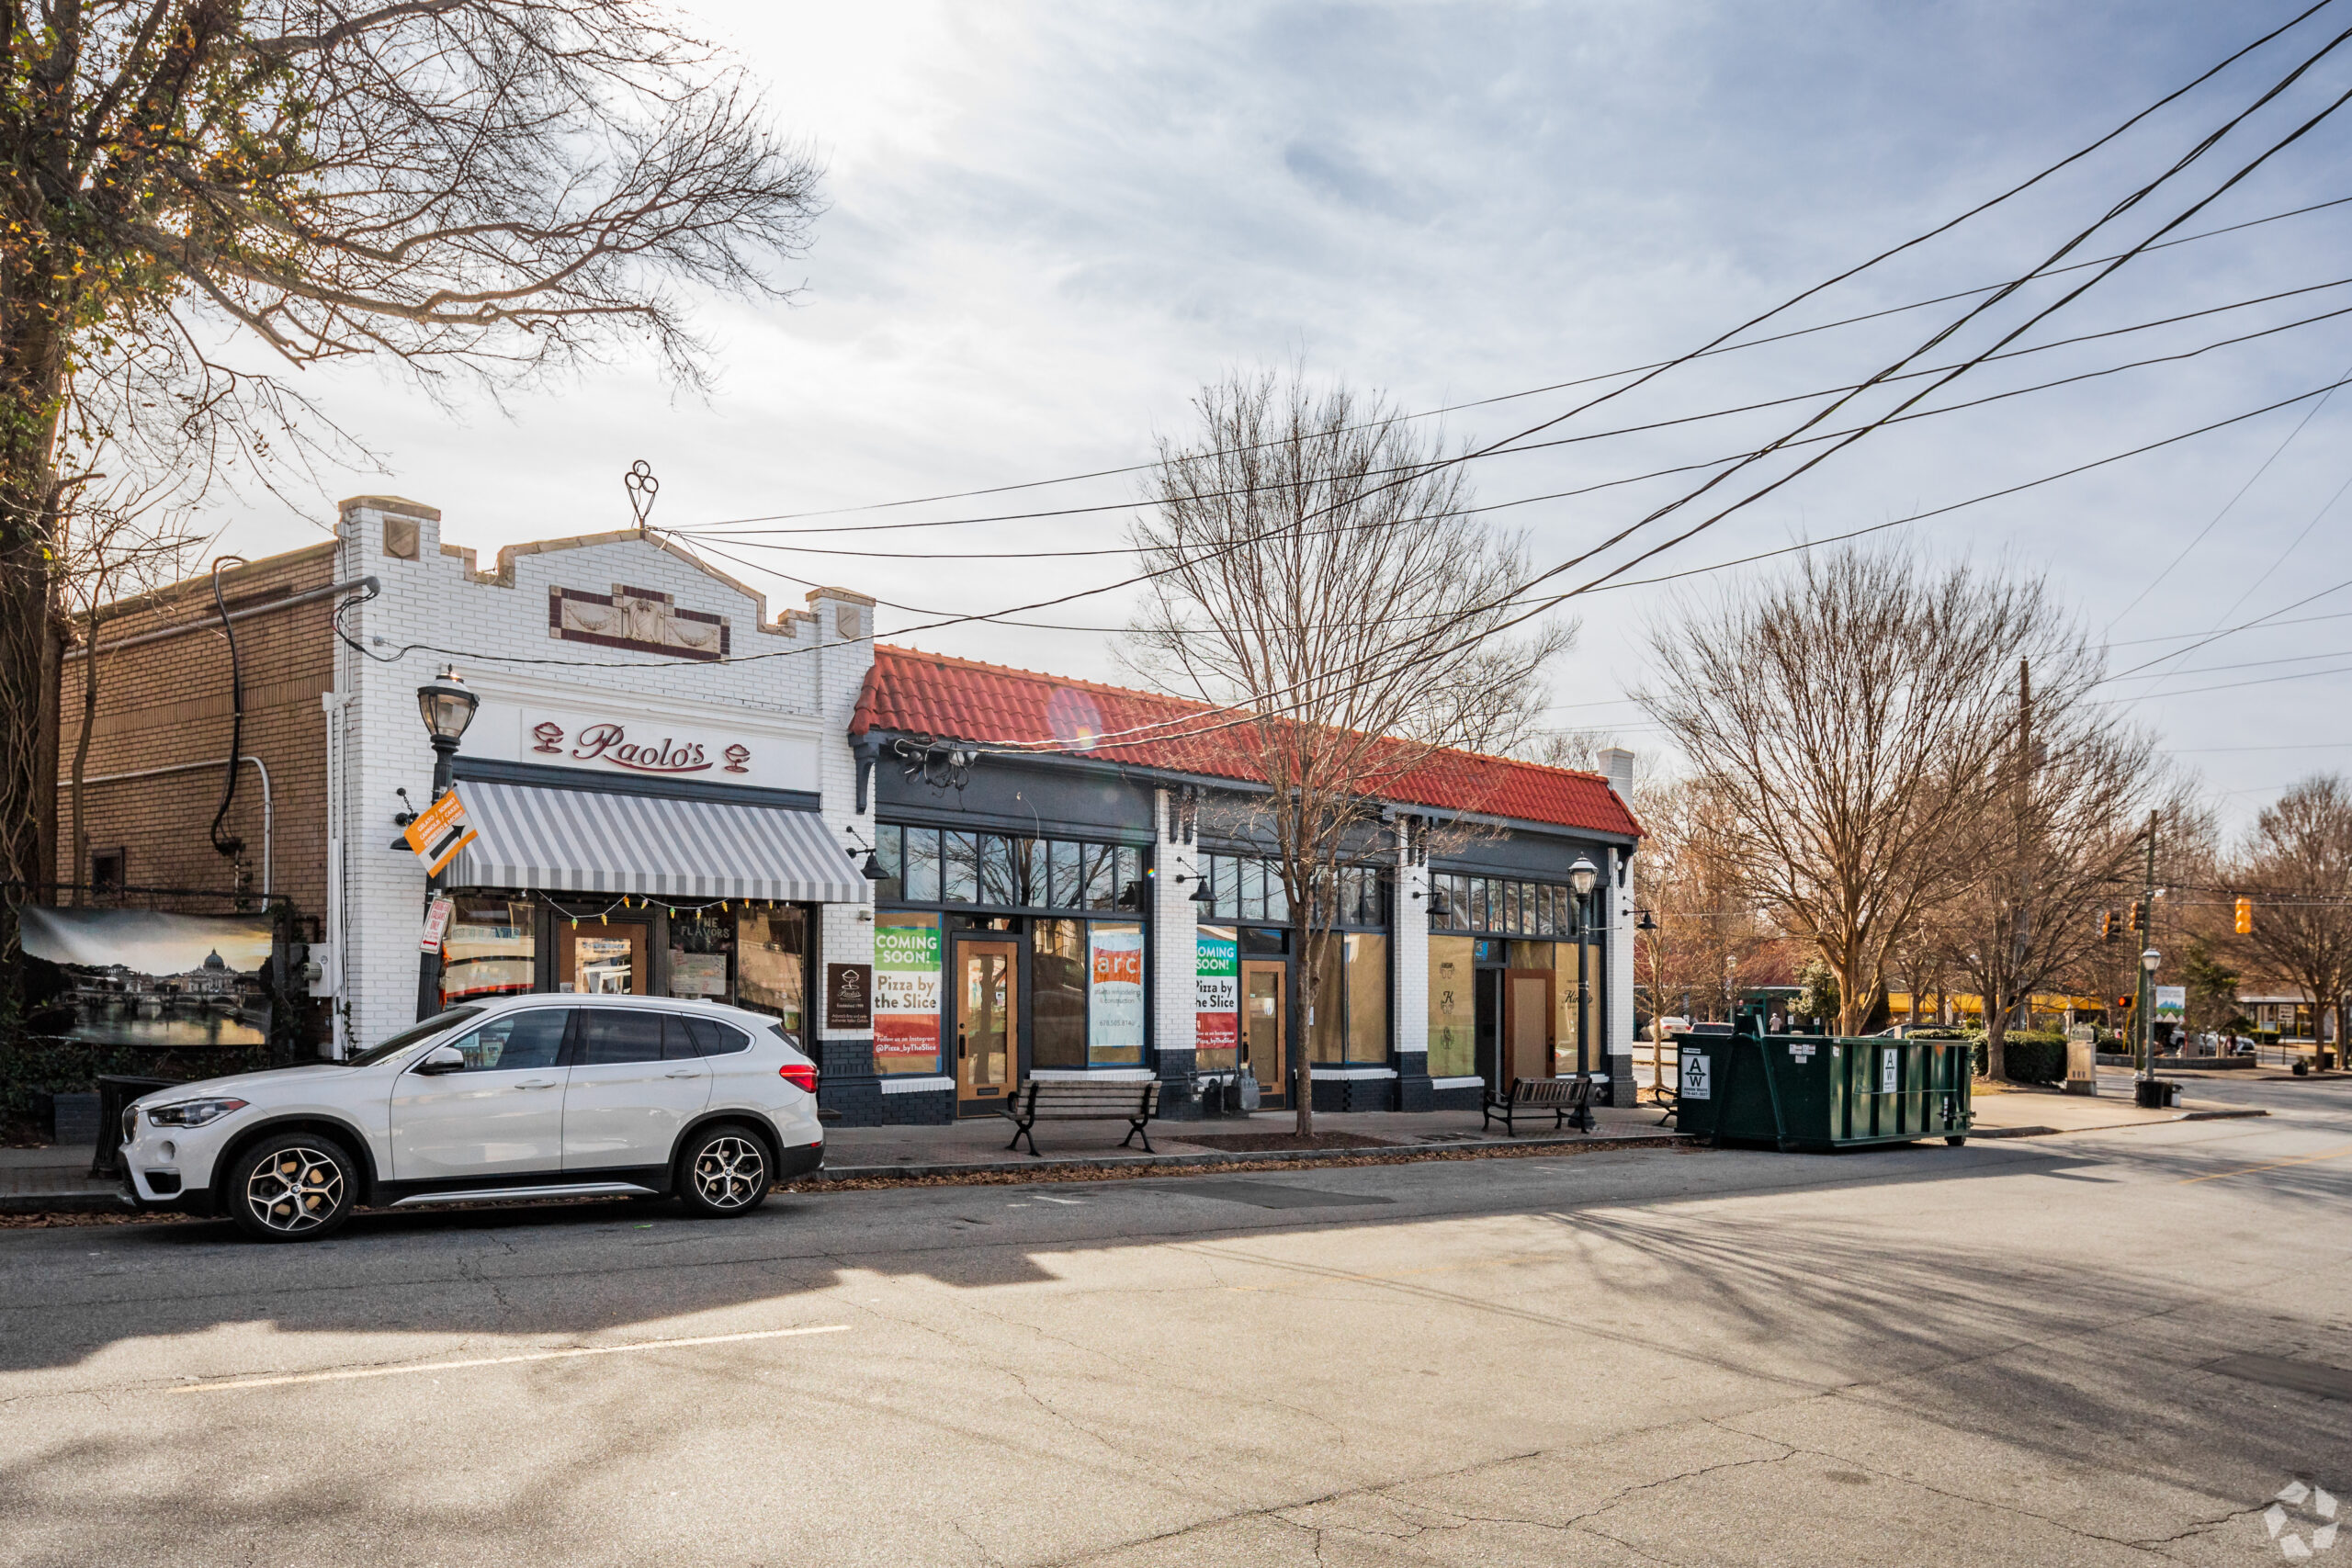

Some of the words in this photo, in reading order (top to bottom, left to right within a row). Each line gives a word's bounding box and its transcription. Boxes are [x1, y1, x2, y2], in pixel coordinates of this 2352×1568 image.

[572, 723, 713, 773] Paolo's
[681, 925, 730, 938] FLAVORS
[876, 935, 937, 949] COMING
[883, 950, 930, 964] SOON!
[1197, 946, 1234, 958] OMING
[1098, 956, 1136, 974] arc
[877, 975, 913, 990] Pizza
[918, 976, 935, 997] by
[1221, 980, 1232, 998] by
[875, 993, 898, 1008] the
[903, 993, 937, 1008] Slice
[1196, 996, 1207, 1007] he
[1210, 995, 1234, 1008] Slice
[876, 1044, 936, 1053] @Pizza_byTheSlice
[1690, 1058, 1702, 1072] A
[1888, 1052, 1893, 1066] A
[1690, 1076, 1702, 1087] W
[1887, 1071, 1892, 1081] W
